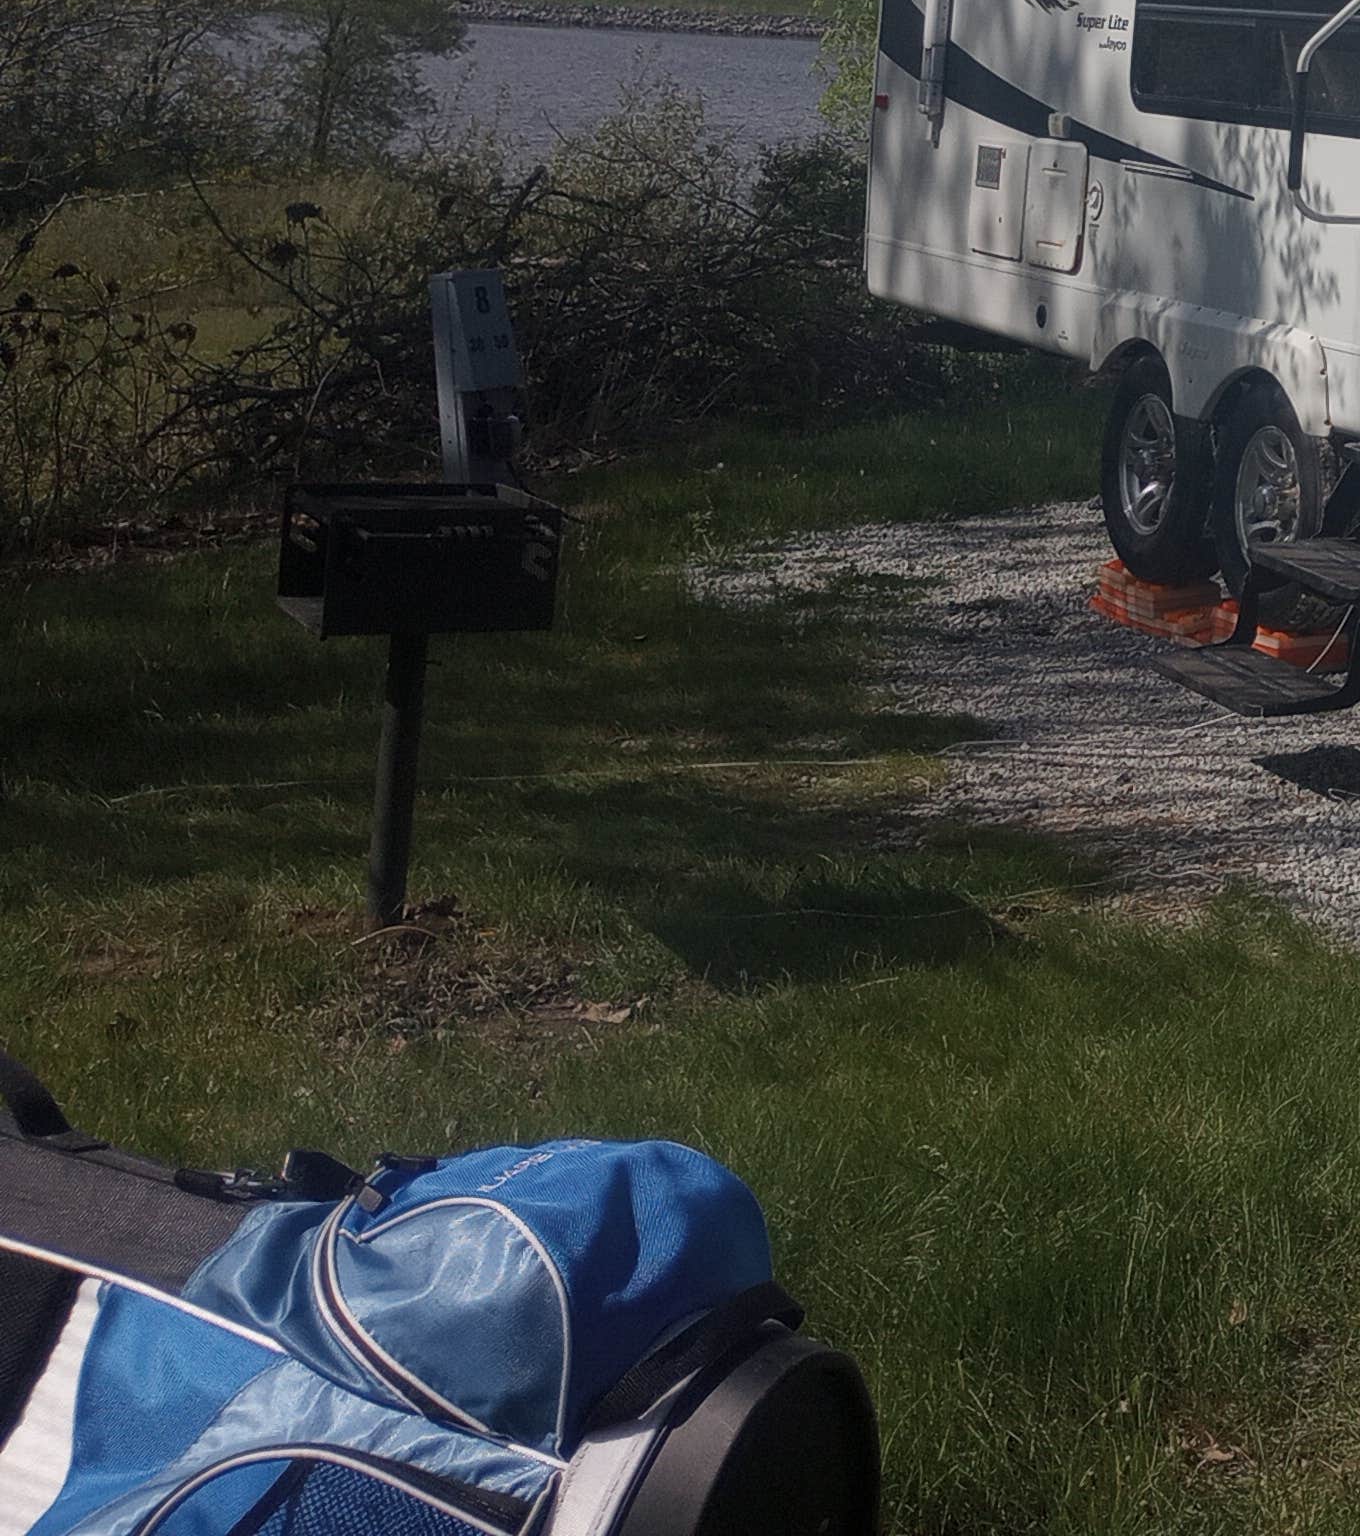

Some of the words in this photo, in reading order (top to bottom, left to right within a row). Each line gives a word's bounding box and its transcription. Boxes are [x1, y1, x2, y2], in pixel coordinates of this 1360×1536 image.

[1075, 12, 1106, 32] Super
[1108, 13, 1129, 31] Lite
[474, 285, 490, 313] 8
